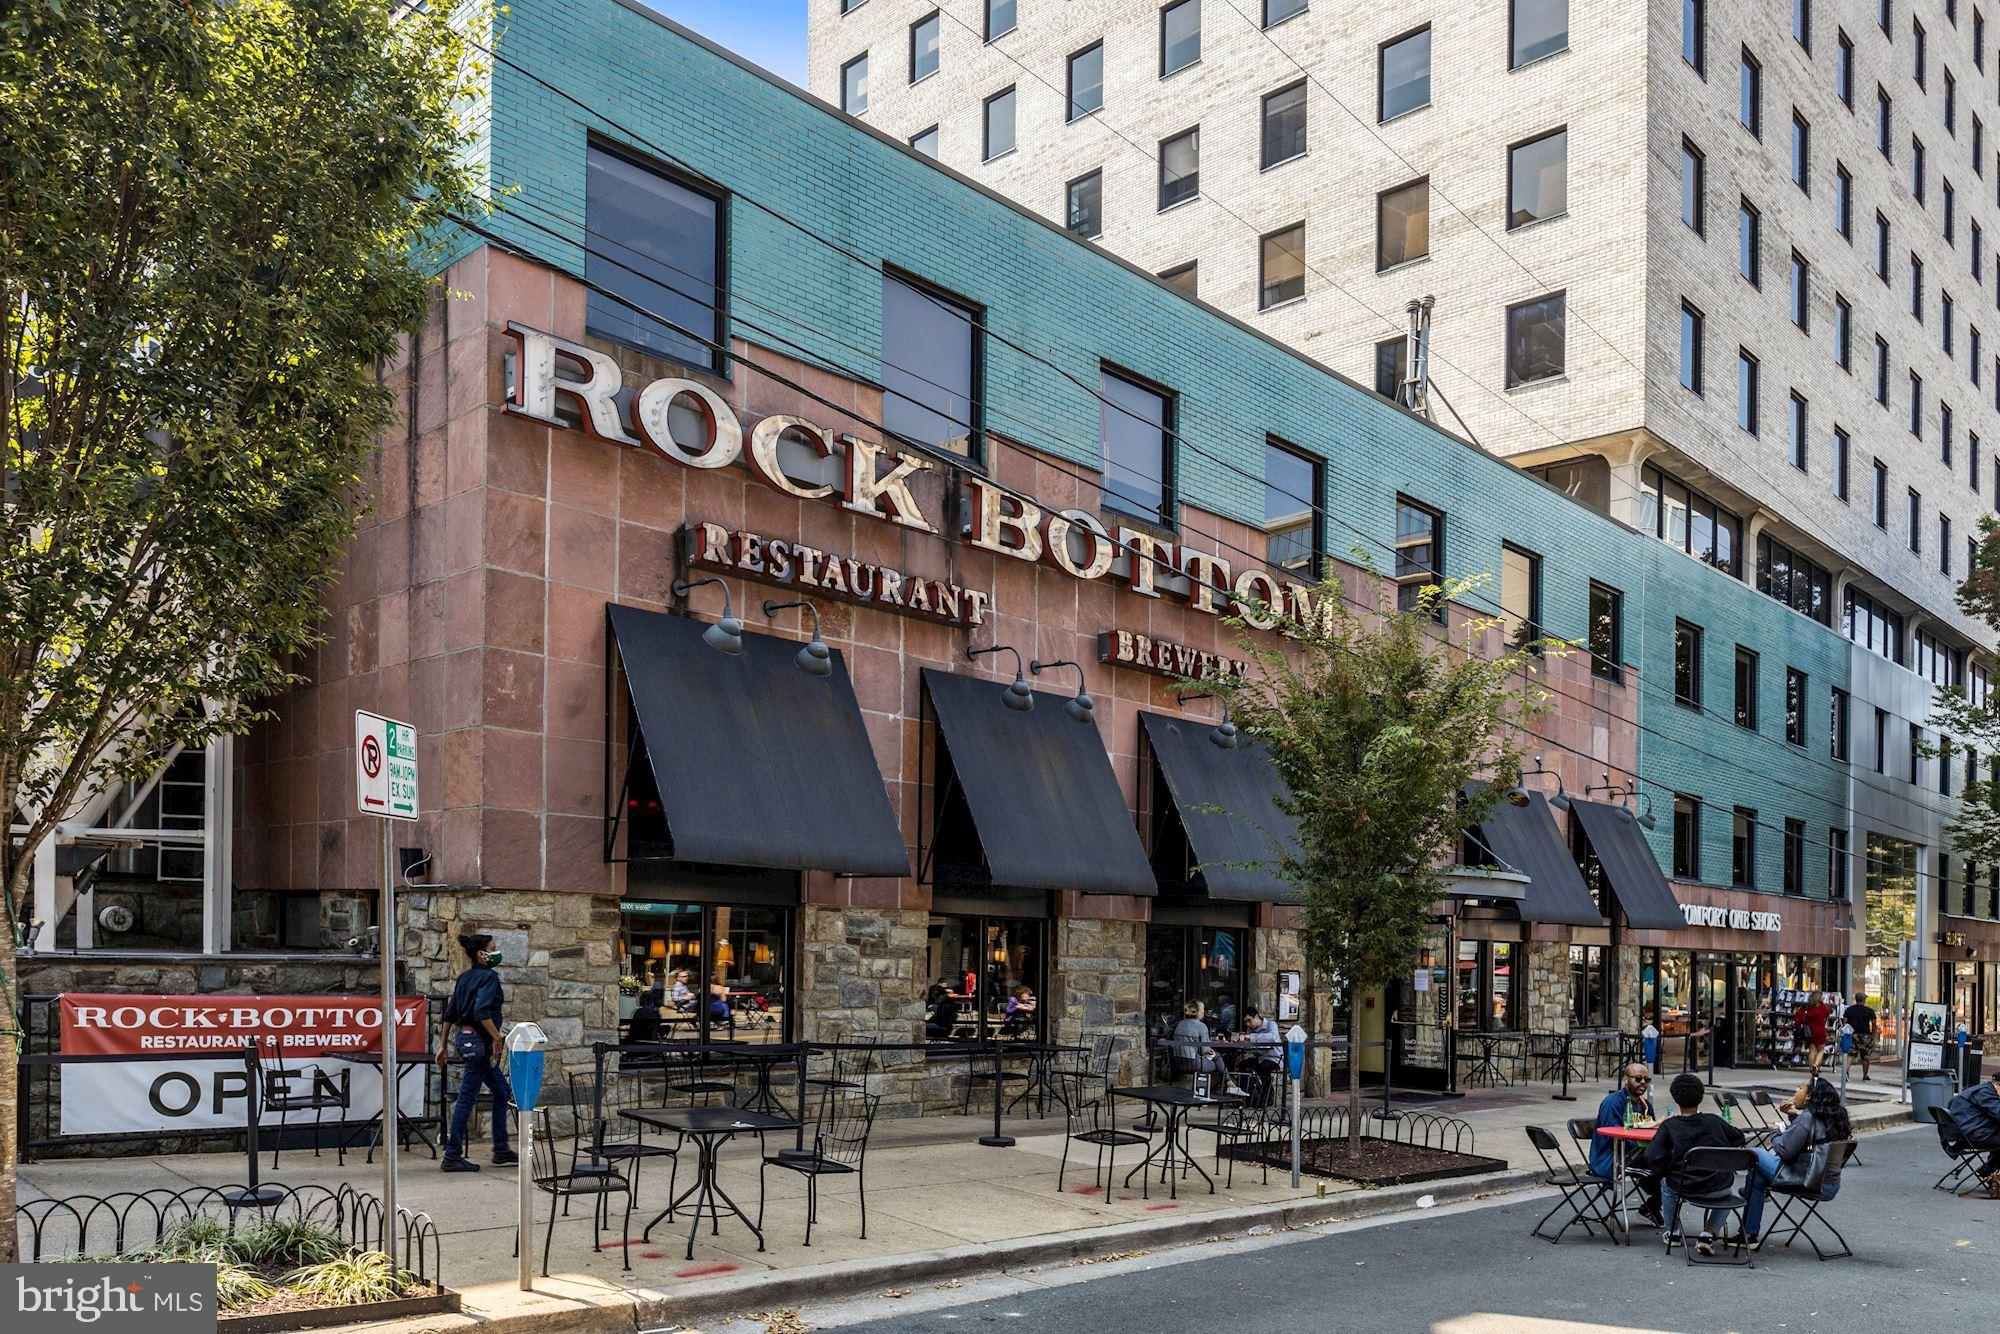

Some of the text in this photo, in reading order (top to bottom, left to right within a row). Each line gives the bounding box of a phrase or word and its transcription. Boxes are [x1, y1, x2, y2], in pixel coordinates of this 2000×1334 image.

[503, 320, 1334, 640] ROCK BOTTOM
[697, 521, 989, 625] RESTAURANT
[389, 728, 396, 749] 2
[402, 784, 415, 800] SUN
[1729, 908, 1750, 929] ONE
[1751, 911, 1781, 932] SHOES
[73, 1006, 417, 1029] ROCK BOTTOM
[1915, 1049, 1939, 1057] Service
[1918, 1056, 1934, 1064] Style
[148, 1067, 351, 1118] OPEN
